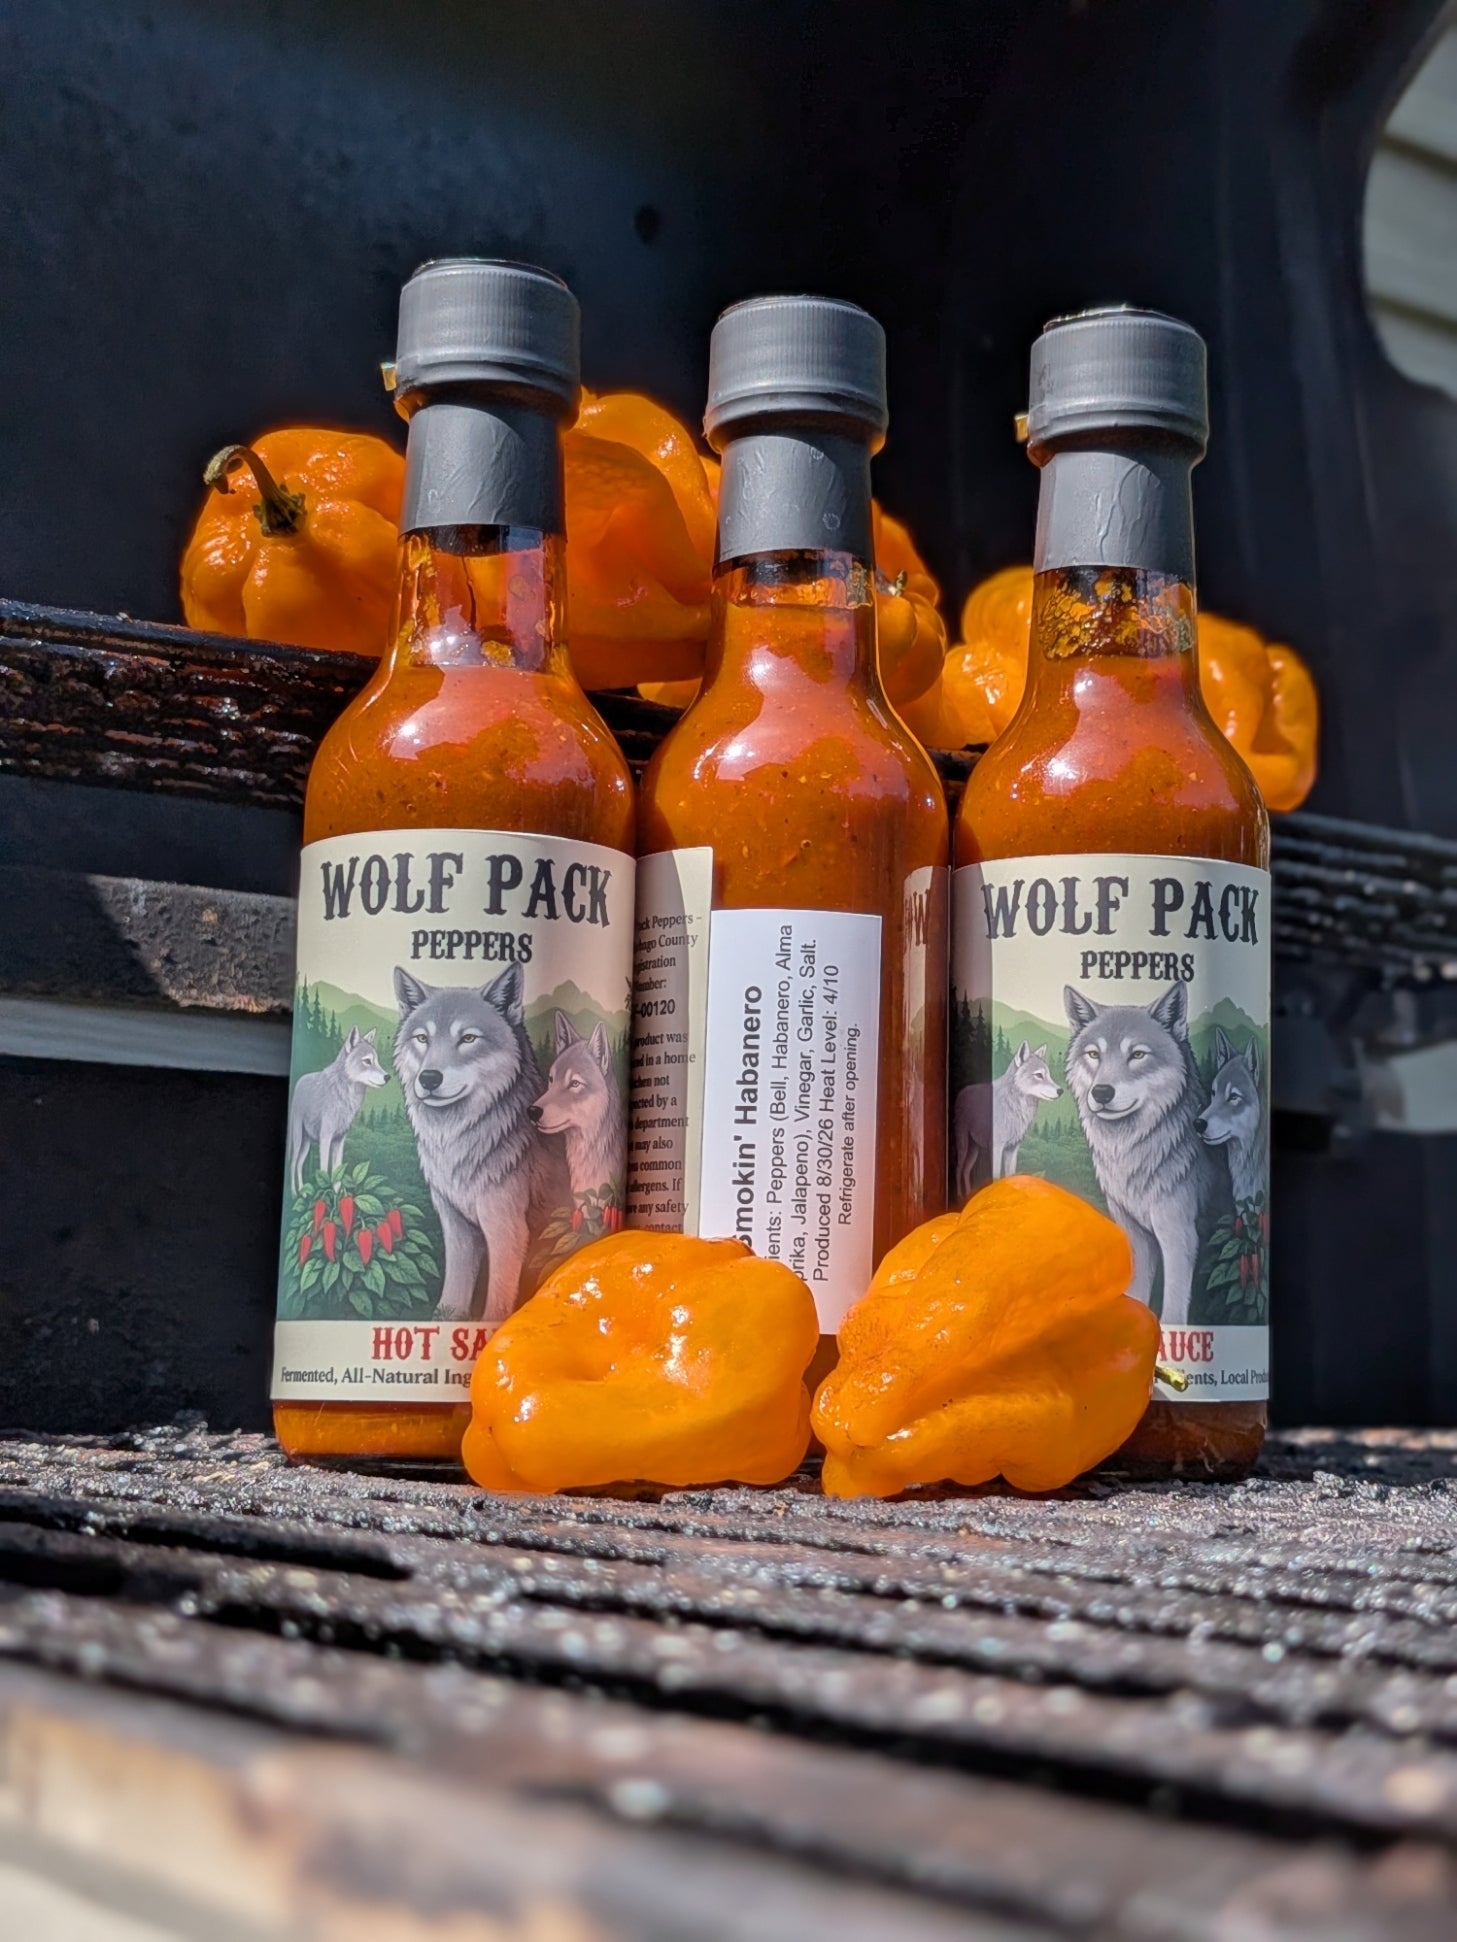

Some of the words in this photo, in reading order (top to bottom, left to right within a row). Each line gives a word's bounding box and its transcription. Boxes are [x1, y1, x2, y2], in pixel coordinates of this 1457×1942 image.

[320, 852, 463, 921] WOLF
[484, 854, 612, 928] PACK
[652, 914, 694, 930] Peppers
[981, 876, 1129, 940] WOLF
[1149, 877, 1260, 946] PACK
[410, 929, 533, 964] PEPPERS
[658, 934, 699, 948] County
[775, 925, 793, 971] Alma
[799, 939, 816, 978] Salt.
[823, 965, 839, 1004] 4/10
[1080, 950, 1195, 983] PEPPERS
[771, 975, 793, 1068] Habanero,
[797, 985, 817, 1042] Garlic,
[666, 1032, 688, 1043] was
[734, 986, 762, 1124] Habanero
[821, 1011, 837, 1063] Level:
[843, 1023, 860, 1091] opening.
[655, 1055, 661, 1065] a
[664, 1051, 696, 1064] home
[654, 1075, 670, 1086] not
[656, 1092, 668, 1110] by
[671, 1096, 677, 1106] a
[769, 1077, 789, 1122] (Bell,
[794, 1050, 815, 1122] Vinegar,
[819, 1069, 835, 1112] Heat
[635, 1117, 690, 1132] department
[842, 1095, 855, 1131] after
[653, 1136, 673, 1149] also
[816, 1119, 833, 1187] 8/30/26
[640, 1160, 682, 1172] common
[672, 1178, 684, 1191] If
[766, 1127, 787, 1204] Peppers
[791, 1129, 813, 1225] Jalapeno),
[838, 1137, 856, 1225] Refrigerate
[655, 1199, 689, 1216] safety
[732, 1135, 756, 1247] Smokin'
[766, 1211, 782, 1260] ients:
[813, 1193, 832, 1281] Produced
[789, 1232, 808, 1281] prika,
[371, 1326, 440, 1360] HOT
[281, 1366, 337, 1385] Fermented,
[341, 1368, 438, 1384] All-Natural
[1220, 1369, 1249, 1385] Local
